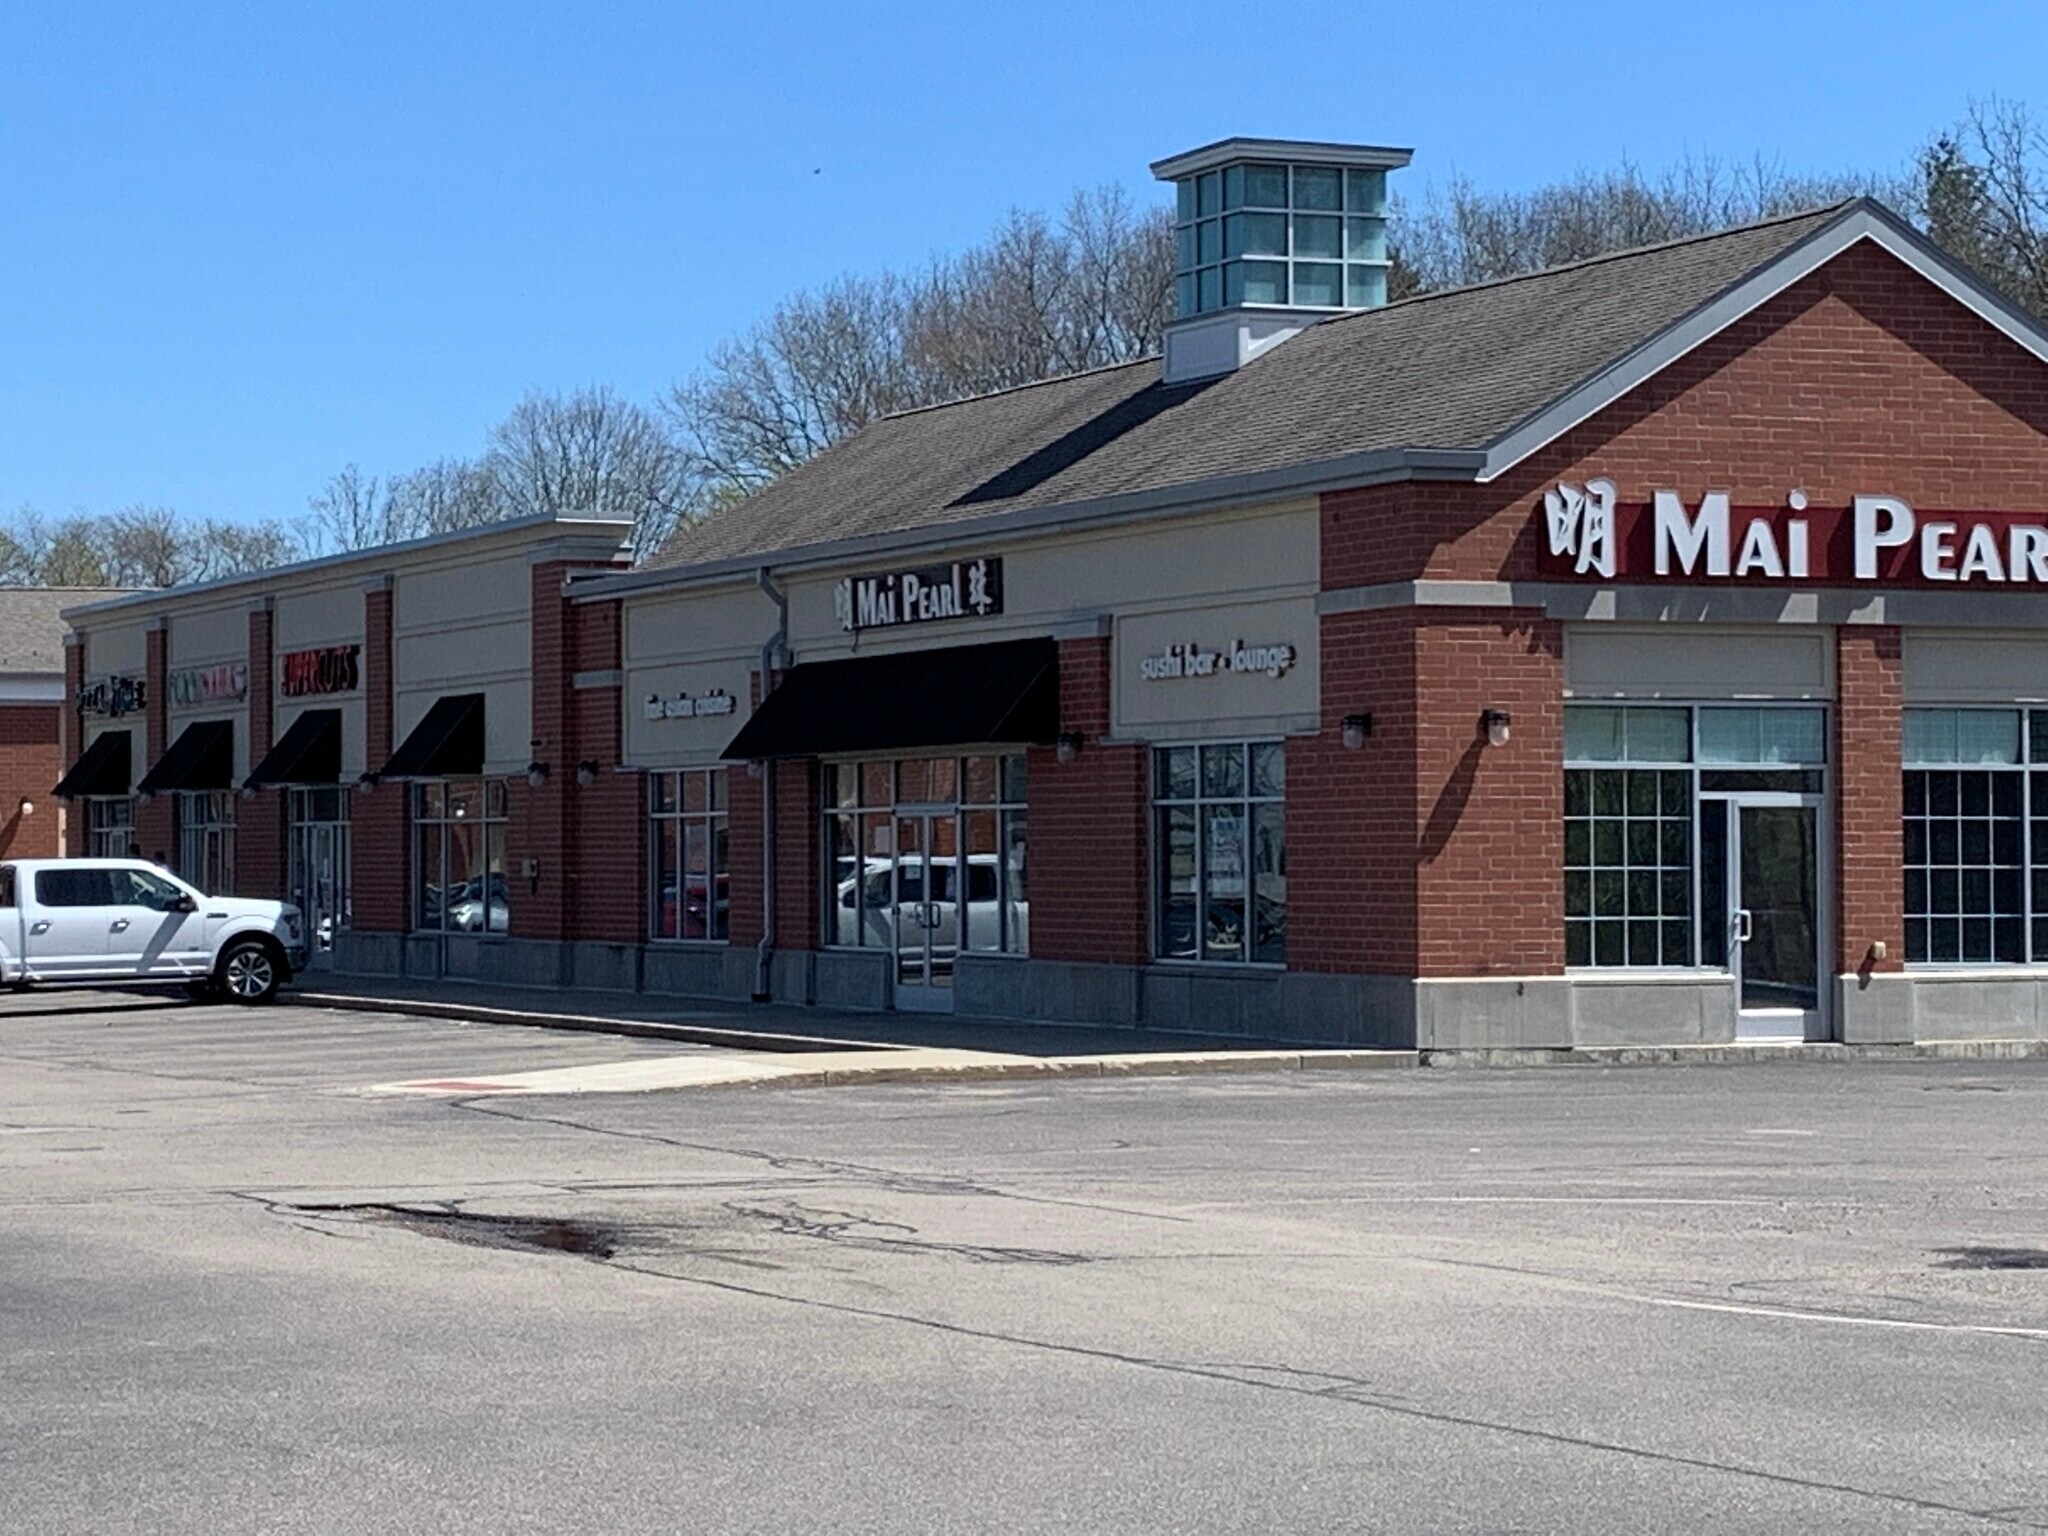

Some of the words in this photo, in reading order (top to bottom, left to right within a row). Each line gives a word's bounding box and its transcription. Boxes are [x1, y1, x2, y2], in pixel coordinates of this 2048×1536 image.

[1141, 646, 1182, 680] sushi
[1184, 643, 1215, 676] bar
[1230, 639, 1292, 678] lounge
